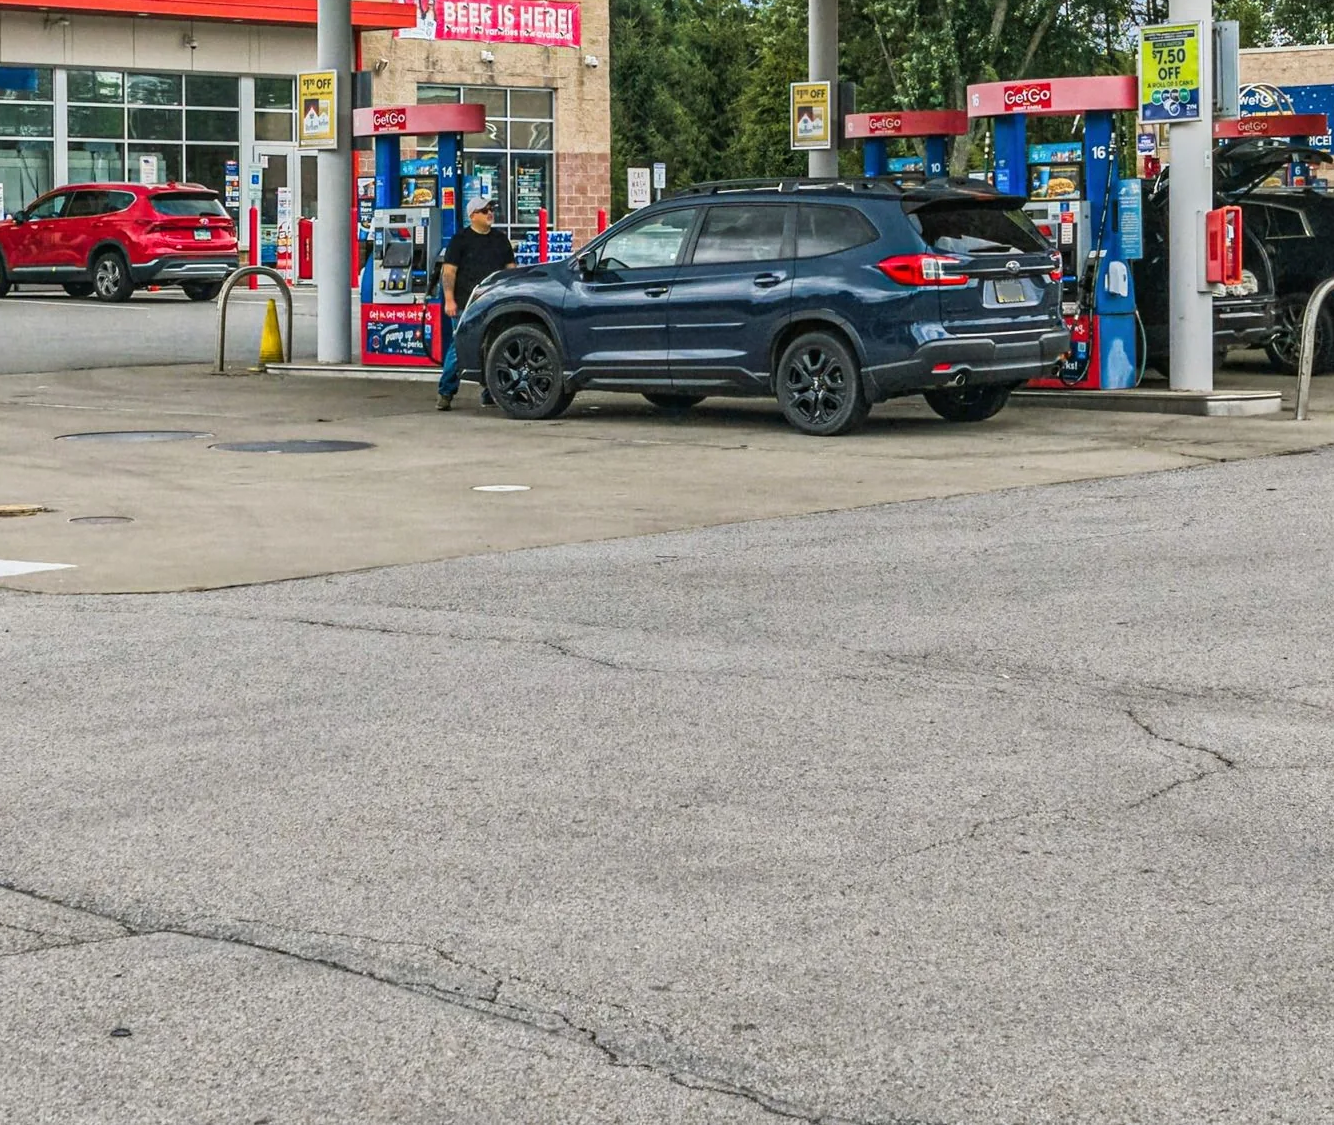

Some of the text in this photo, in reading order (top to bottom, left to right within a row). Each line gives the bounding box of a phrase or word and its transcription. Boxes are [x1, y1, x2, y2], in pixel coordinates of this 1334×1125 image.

[444, 1, 573, 30] BEER IS HERE!
[451, 26, 470, 34] over
[470, 25, 485, 35] 100
[1152, 48, 1186, 65] $7.50
[1158, 66, 1181, 81] OFF
[316, 77, 332, 90] OFF
[810, 88, 827, 99] OFF
[1004, 87, 1051, 105] GetGo
[373, 112, 406, 126] GetGo
[869, 117, 902, 130] GetGo
[1237, 121, 1268, 132] GetGo
[1308, 135, 1332, 146] RICE!
[1091, 145, 1107, 160] 16
[441, 166, 453, 178] 14
[930, 162, 941, 173] 10
[1294, 166, 1301, 176] 6
[384, 330, 414, 345] pump up
[407, 340, 424, 349] perks
